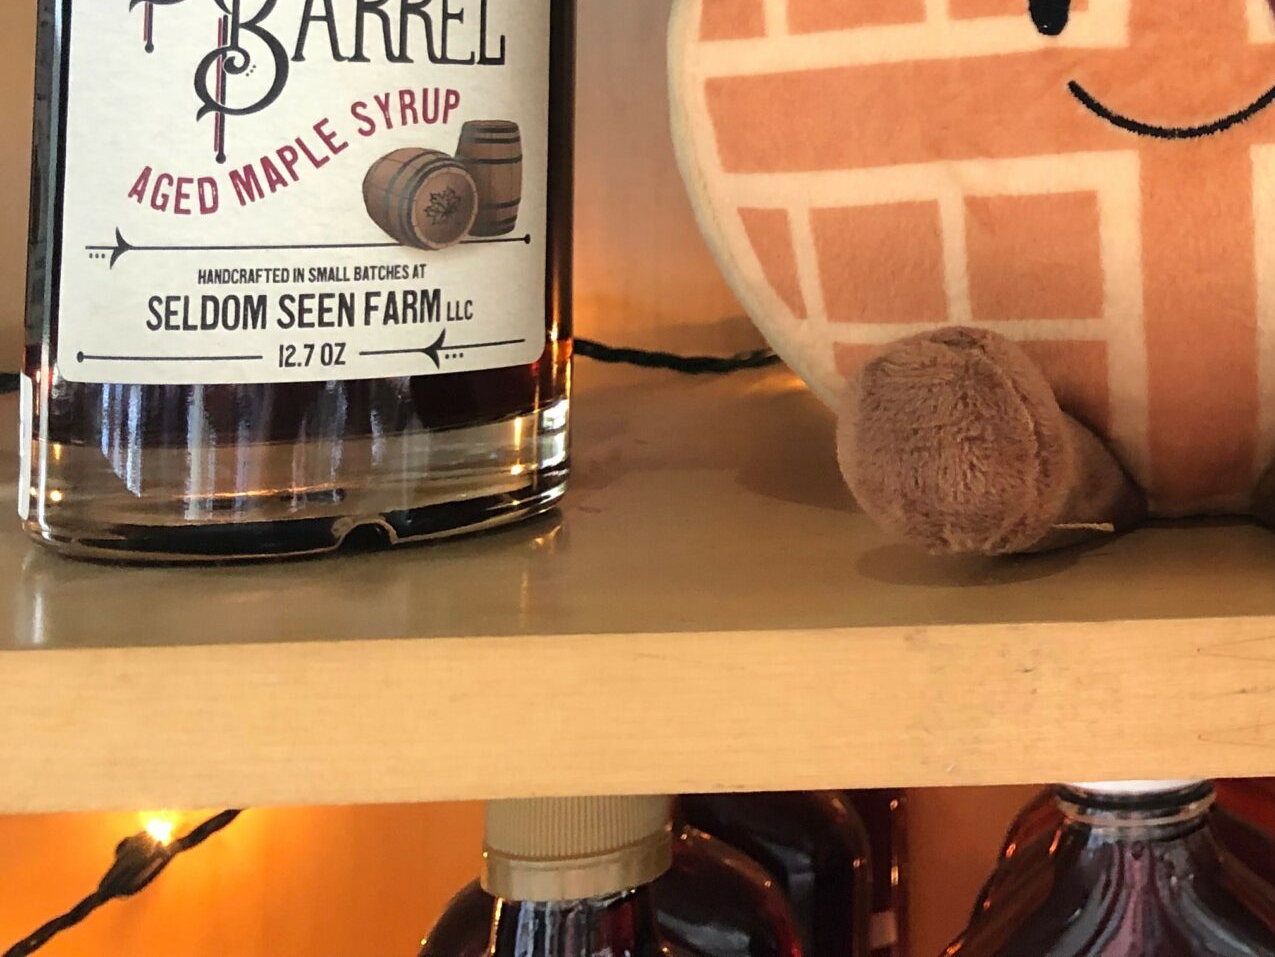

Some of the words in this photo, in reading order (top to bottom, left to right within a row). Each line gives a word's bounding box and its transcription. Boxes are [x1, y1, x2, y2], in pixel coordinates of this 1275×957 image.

[127, 165, 219, 215] AGED
[228, 117, 350, 207] MAPLE
[350, 87, 461, 137] SYRUP
[198, 267, 290, 285] HANDCRAFTED
[292, 267, 305, 284] IN
[308, 265, 350, 283] SMALL
[353, 264, 410, 282] BATCHES
[412, 263, 427, 280] AT
[146, 294, 268, 331] SELDOM
[276, 292, 355, 329] SEEN
[364, 288, 442, 326] FARM
[446, 299, 474, 322] LLC
[278, 343, 315, 368] 12.7
[320, 342, 347, 366] OZ
